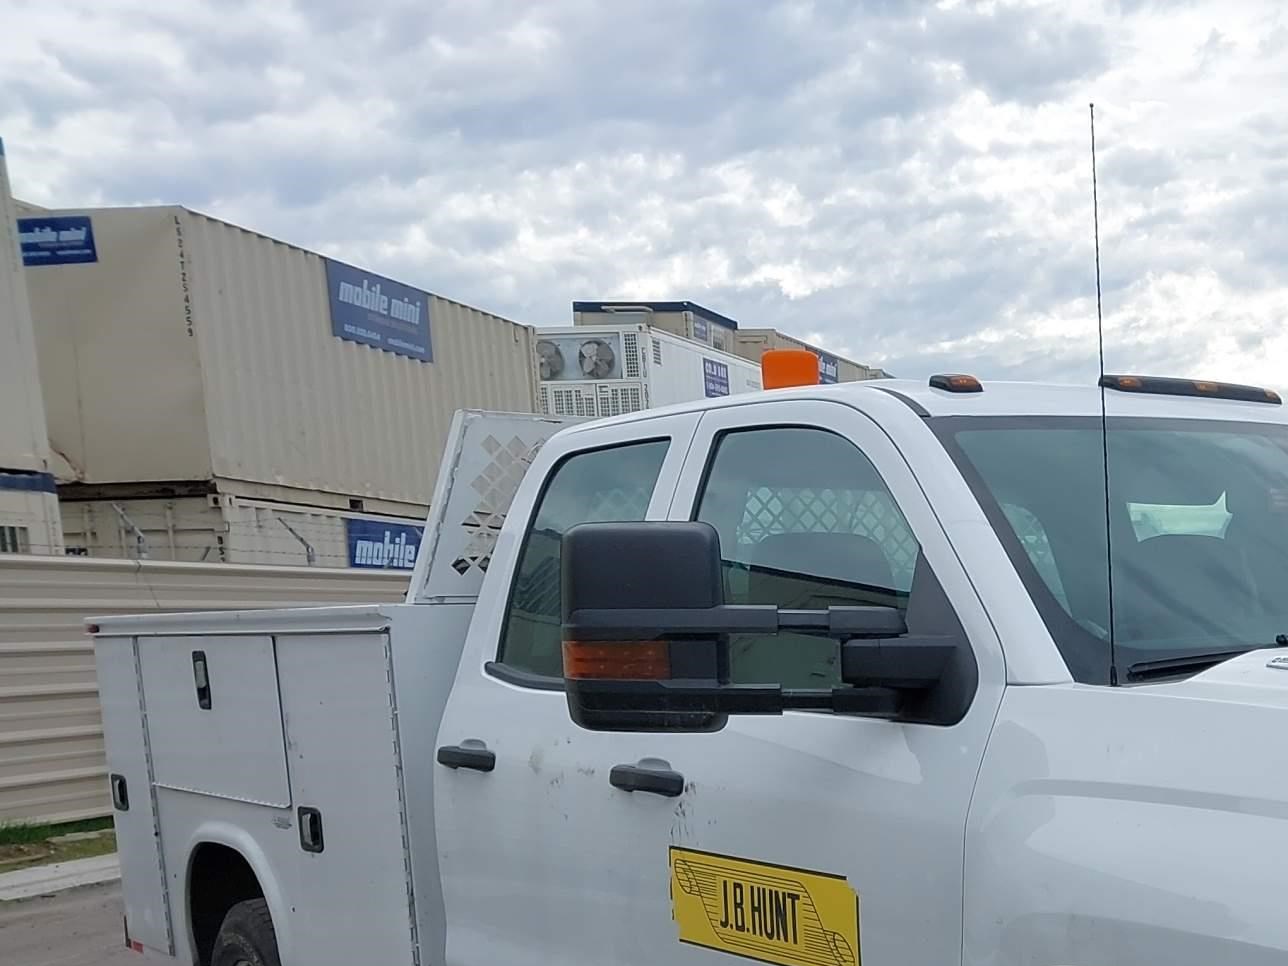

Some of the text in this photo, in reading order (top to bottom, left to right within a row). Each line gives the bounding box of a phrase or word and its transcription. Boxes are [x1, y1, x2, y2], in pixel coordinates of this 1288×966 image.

[338, 279, 389, 315] mobile
[390, 297, 421, 325] mini
[354, 530, 417, 568] mobile
